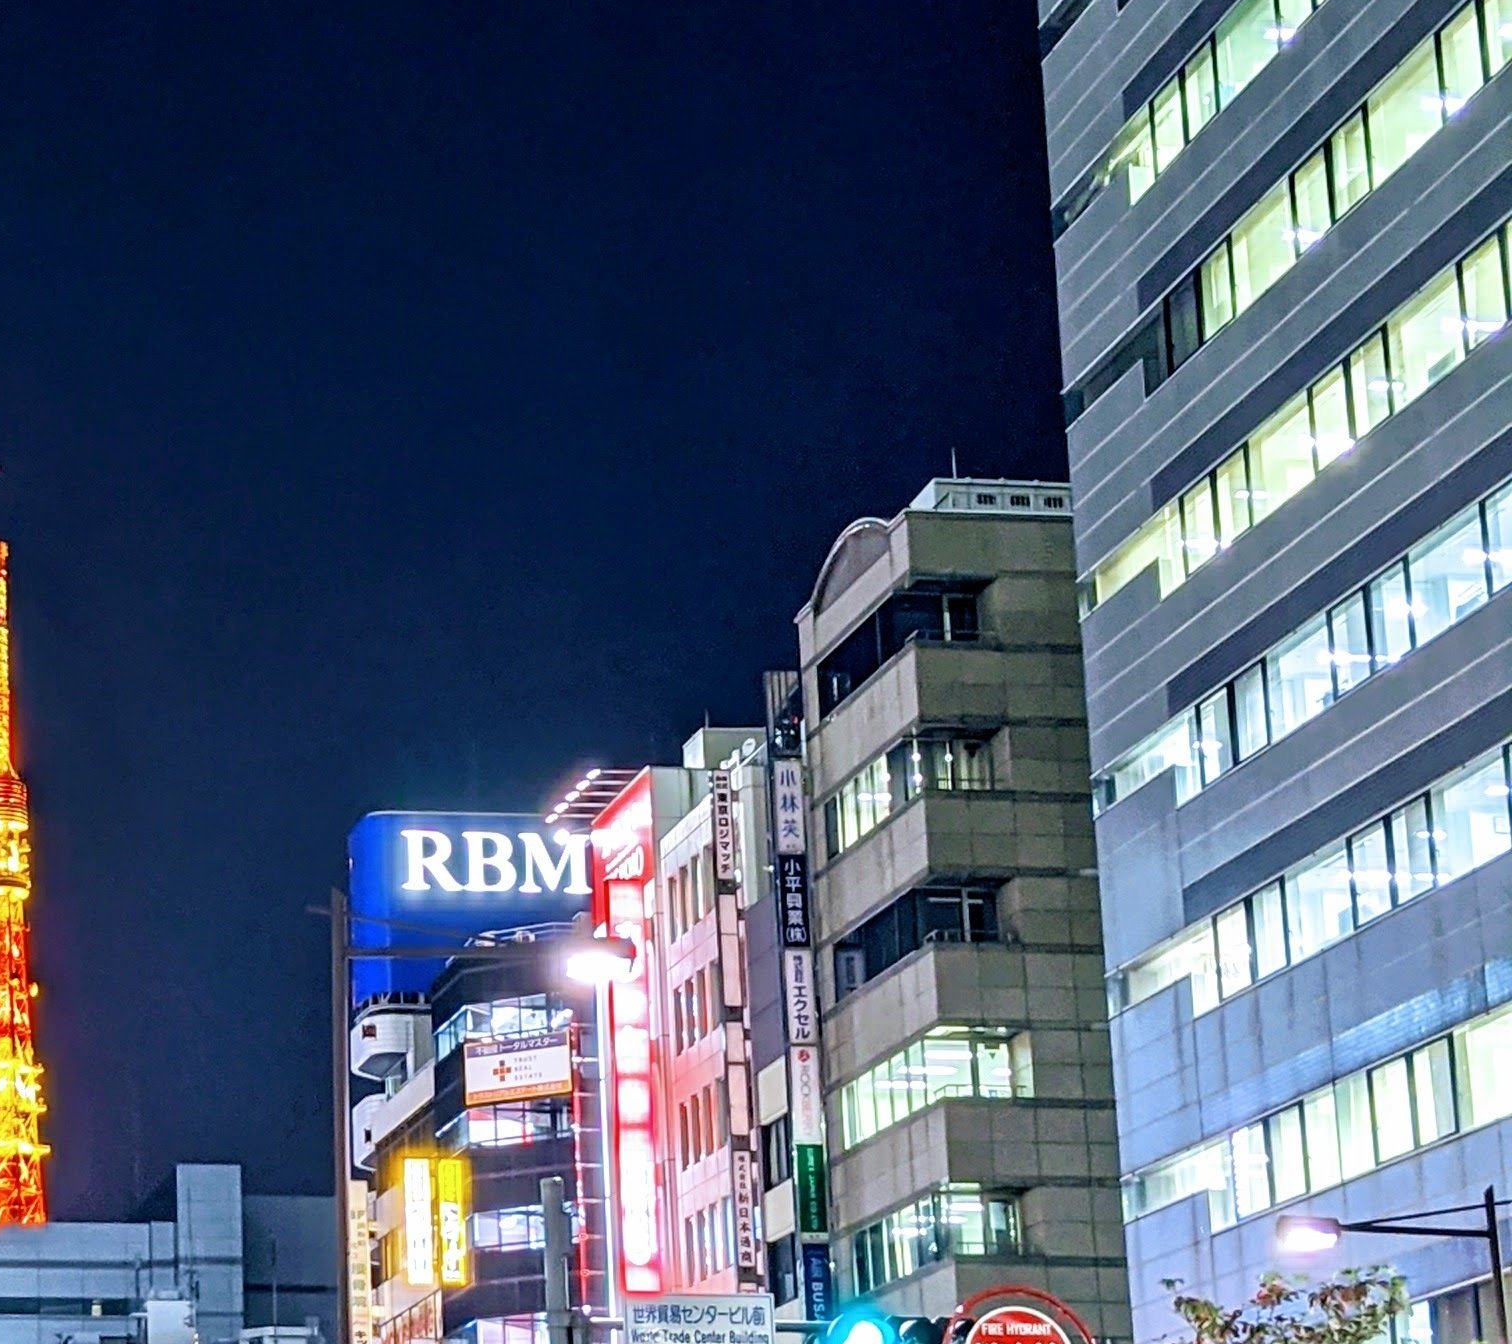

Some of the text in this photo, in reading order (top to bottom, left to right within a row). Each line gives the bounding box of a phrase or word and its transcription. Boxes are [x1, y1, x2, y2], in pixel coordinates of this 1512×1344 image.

[400, 829, 593, 895] RBM
[633, 1304, 765, 1326] 世界貿易センタービル前
[663, 1329, 691, 1343] Trade
[694, 1330, 726, 1344] Center
[981, 1323, 1052, 1336] FIRE HYDRANT
